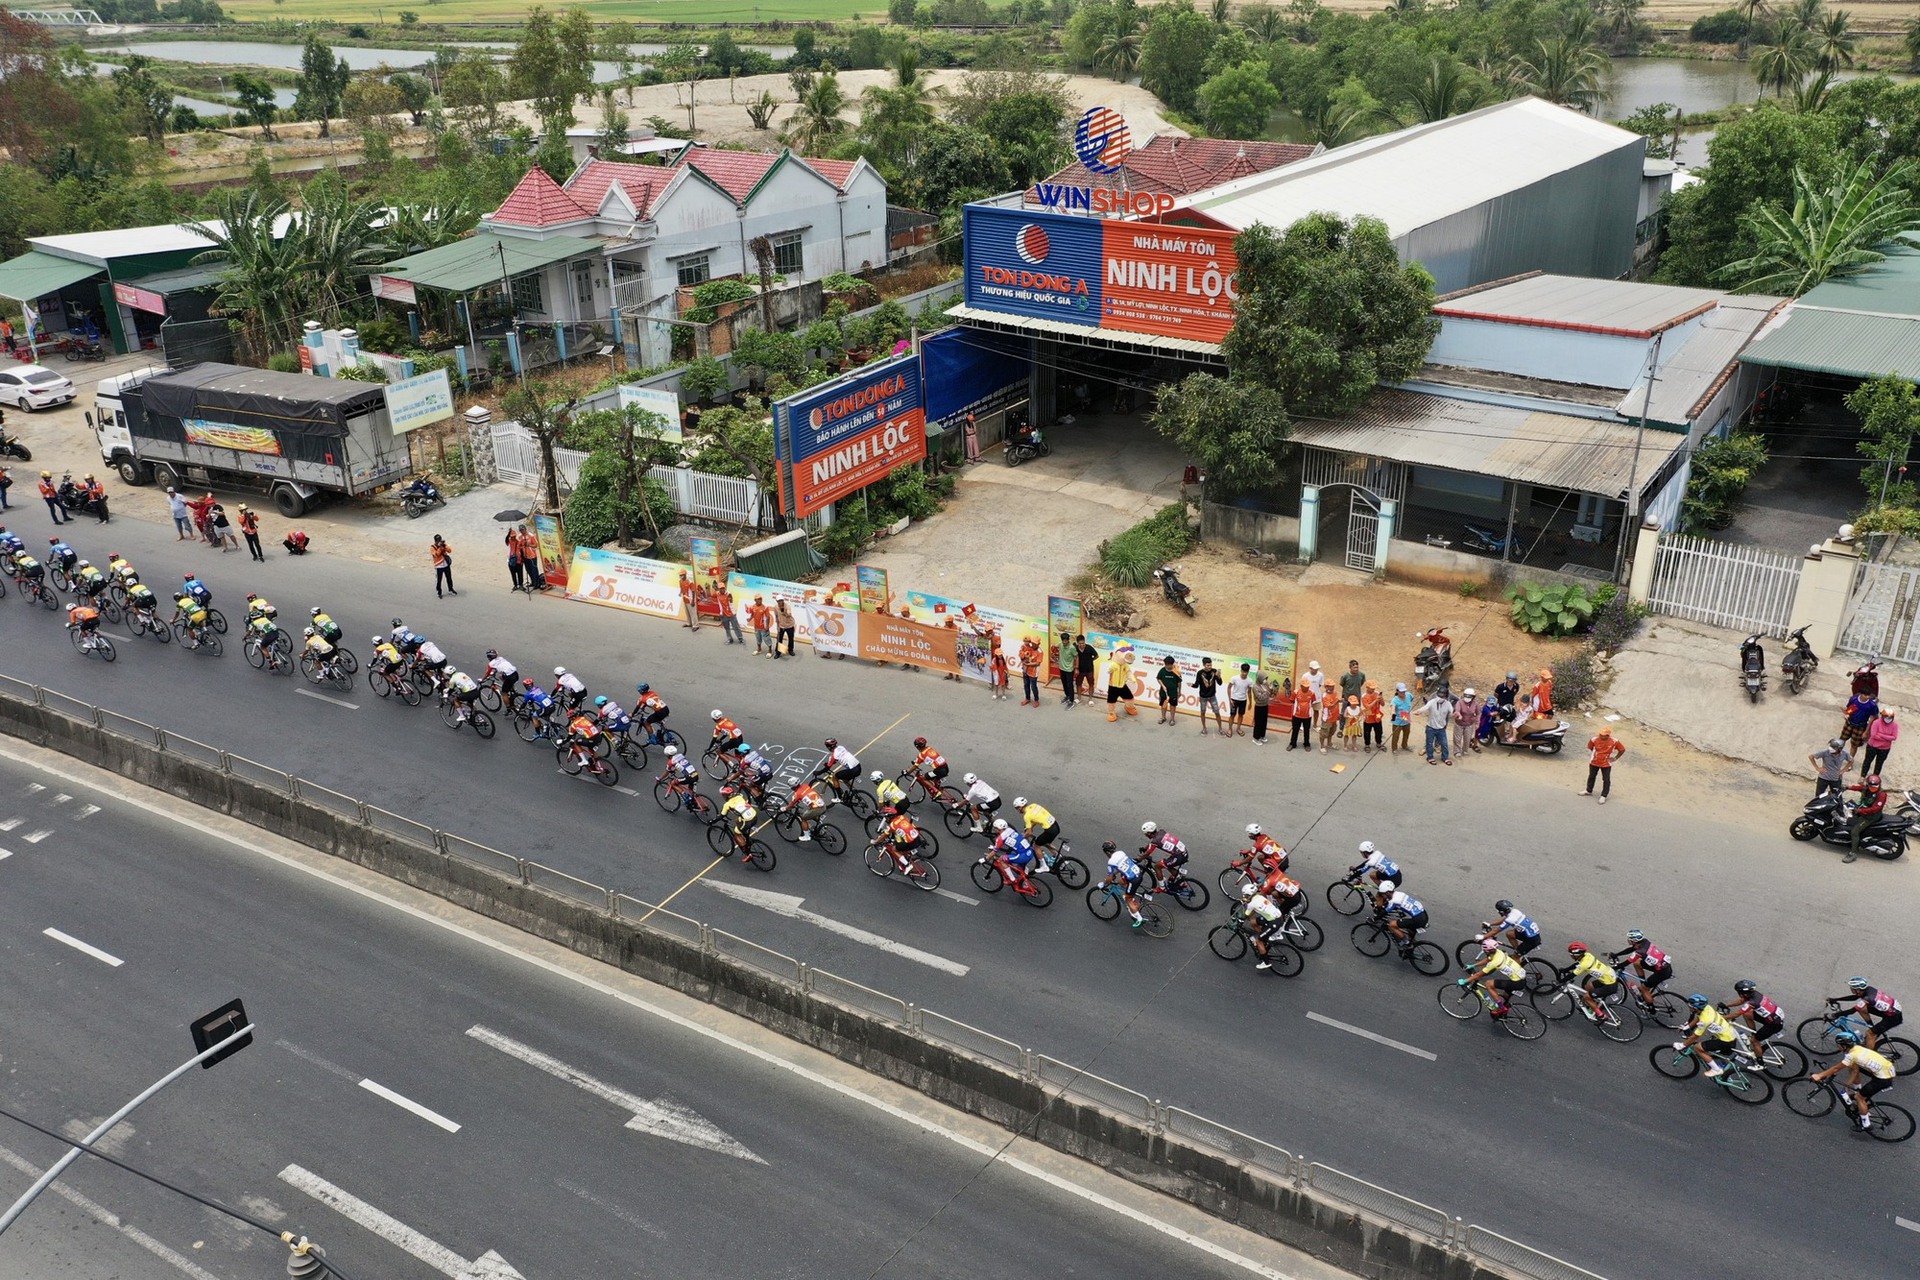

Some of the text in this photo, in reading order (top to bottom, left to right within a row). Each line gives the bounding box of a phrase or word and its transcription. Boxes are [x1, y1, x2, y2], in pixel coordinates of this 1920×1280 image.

[1035, 182, 1175, 217] WINSHOP
[1133, 234, 1216, 256] NHÀ MÁY TÔN
[981, 265, 1090, 296] TON DONG A
[1107, 258, 1177, 293] NINH
[981, 285, 1071, 306] THƯƠNG HIỆU QUỐC GIA
[823, 374, 906, 421] TON DONG A
[831, 423, 850, 439] HÀNH
[811, 440, 867, 486] NINH
[872, 420, 910, 456] LỘC
[589, 575, 618, 600] 25
[615, 592, 675, 612] TON DONG A
[815, 610, 845, 637] 25
[912, 628, 925, 637] TÔN
[881, 634, 931, 651] NINH LỘC
[865, 644, 886, 653] CHÀO
[911, 651, 931, 661] ĐOÀN
[932, 656, 947, 665] ĐUA
